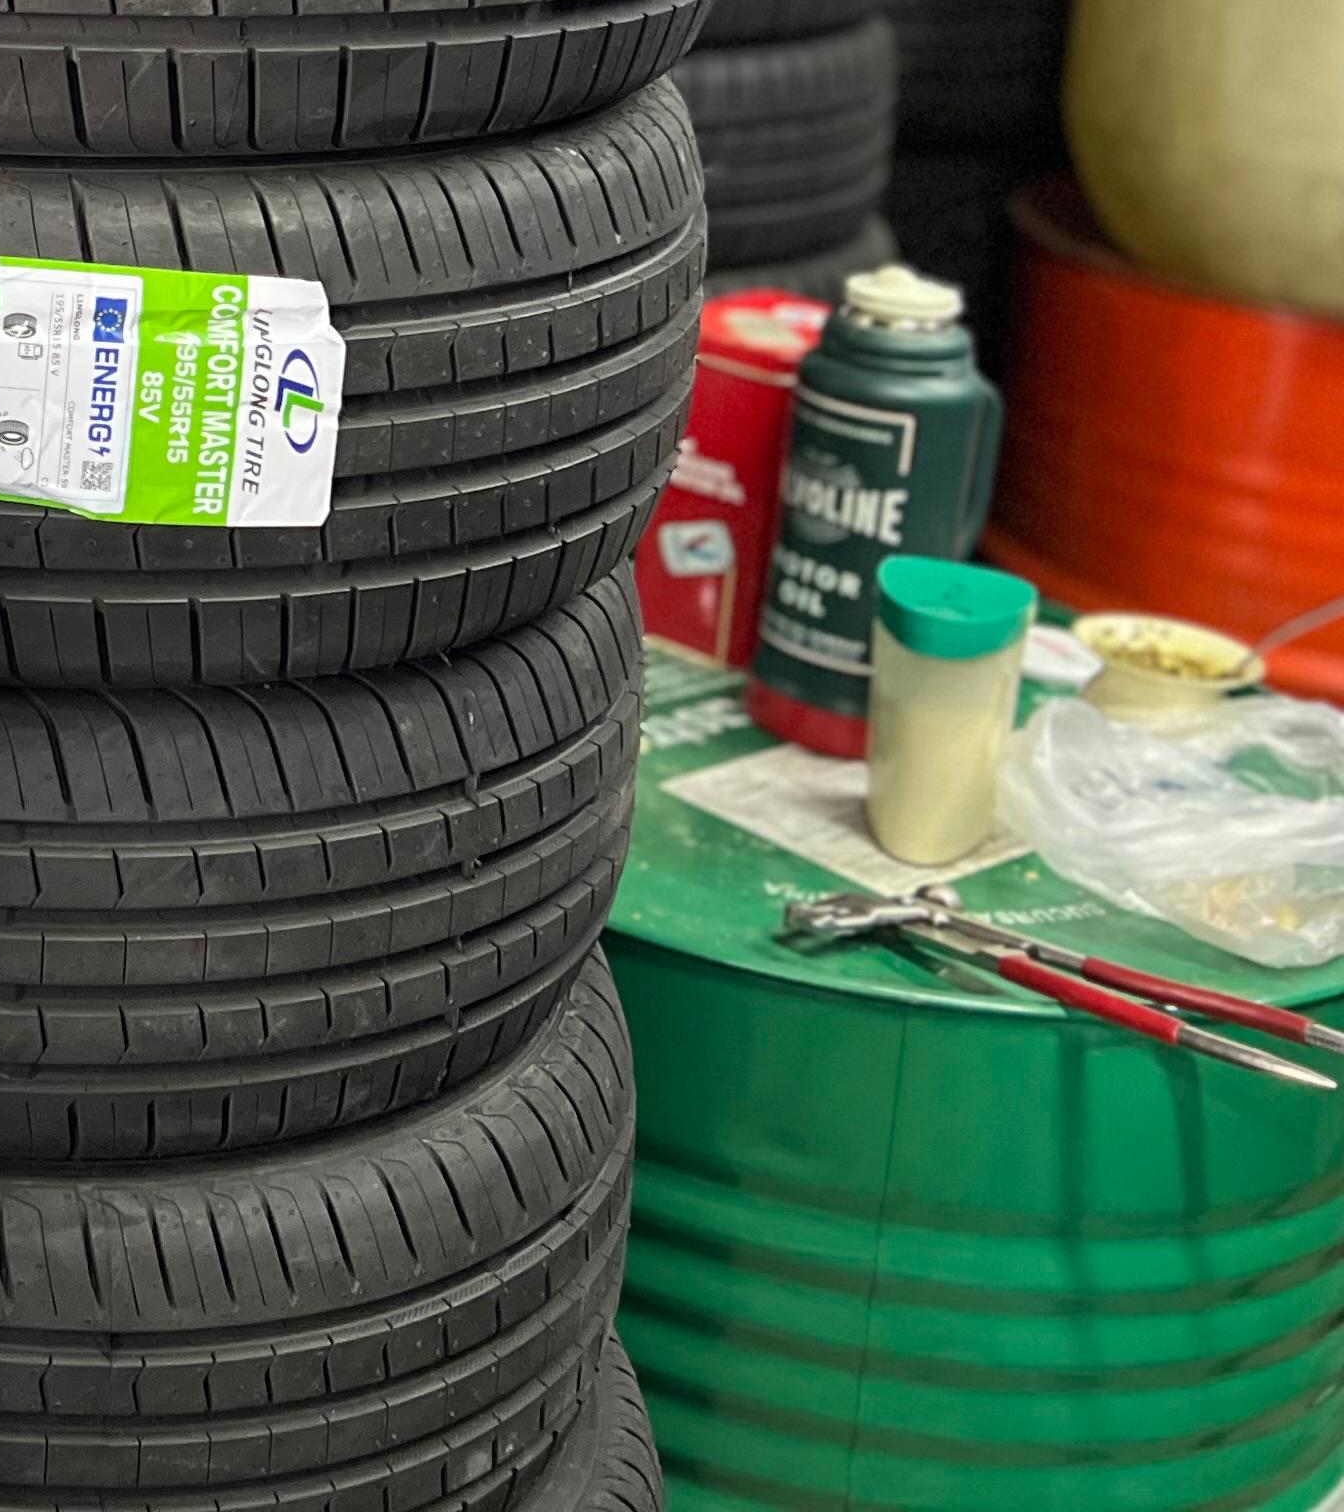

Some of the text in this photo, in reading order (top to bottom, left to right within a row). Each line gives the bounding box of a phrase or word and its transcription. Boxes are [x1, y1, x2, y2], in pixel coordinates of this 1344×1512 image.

[139, 370, 165, 424] 85V
[192, 285, 243, 515] COMFORT MASTER
[241, 435, 265, 495] TIRE
[972, 902, 1106, 925] SUCURSA
